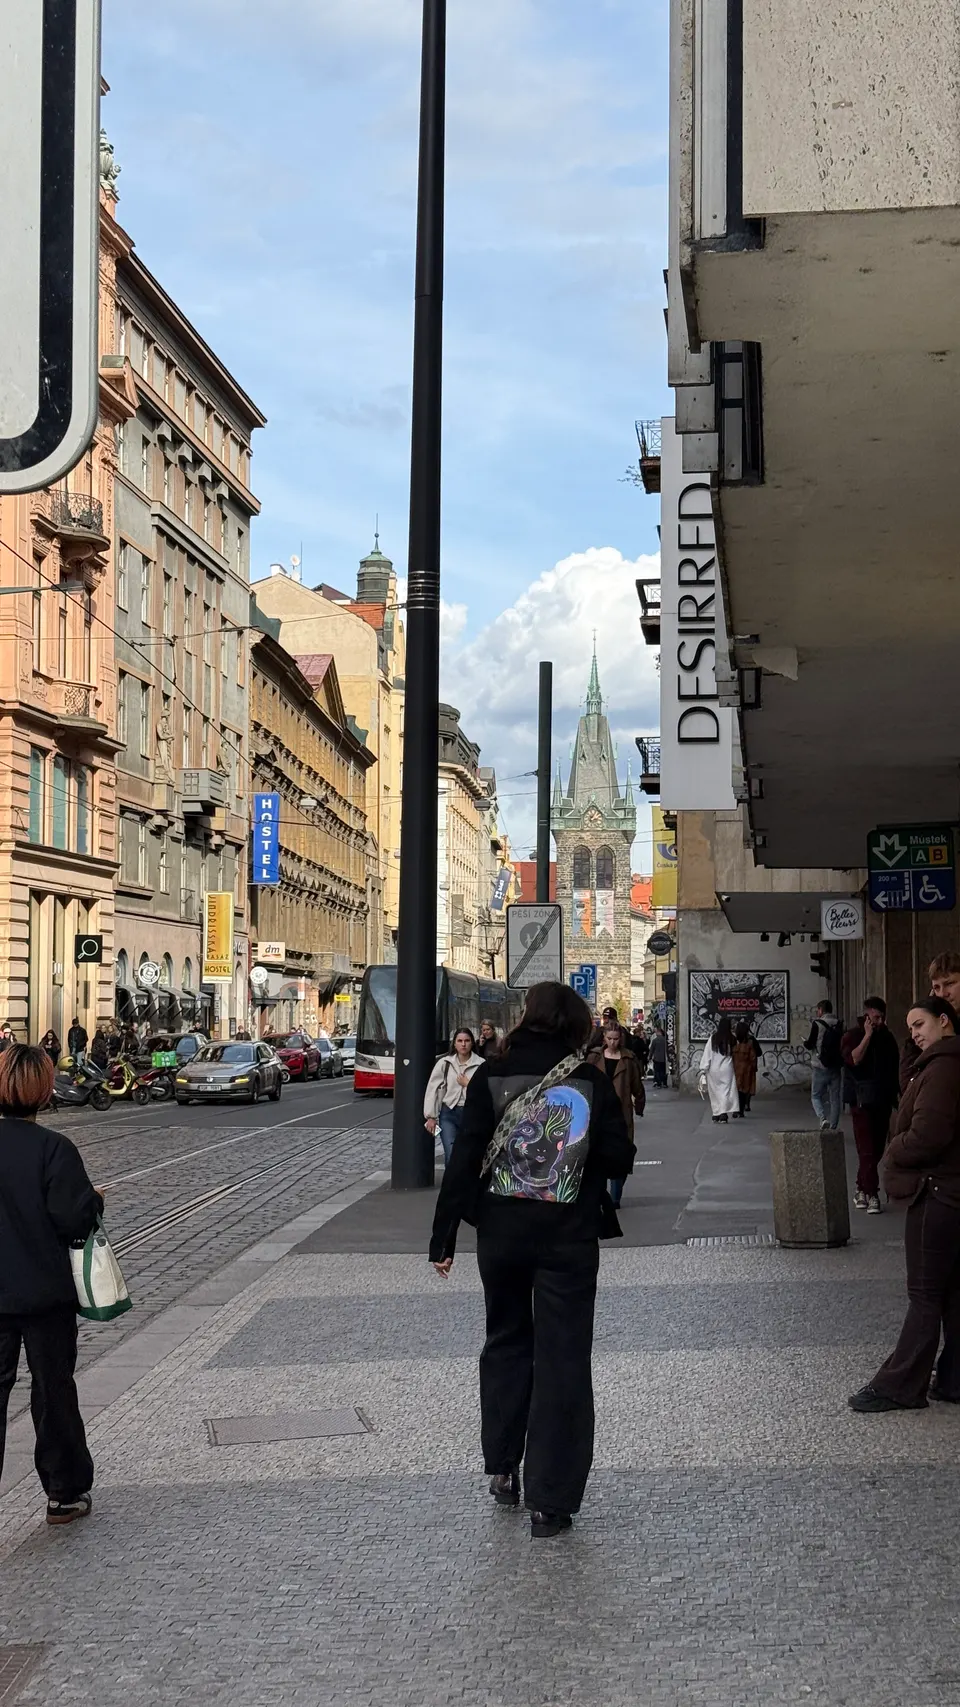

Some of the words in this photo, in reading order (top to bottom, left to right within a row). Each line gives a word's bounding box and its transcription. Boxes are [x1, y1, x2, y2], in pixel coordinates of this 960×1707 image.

[261, 798, 273, 879] HOSTEL
[915, 849, 927, 862] A
[933, 848, 943, 861] B
[533, 908, 556, 918] ZÓN
[264, 944, 280, 954] dm
[204, 965, 231, 973] HOSTEL
[574, 975, 585, 991] P
